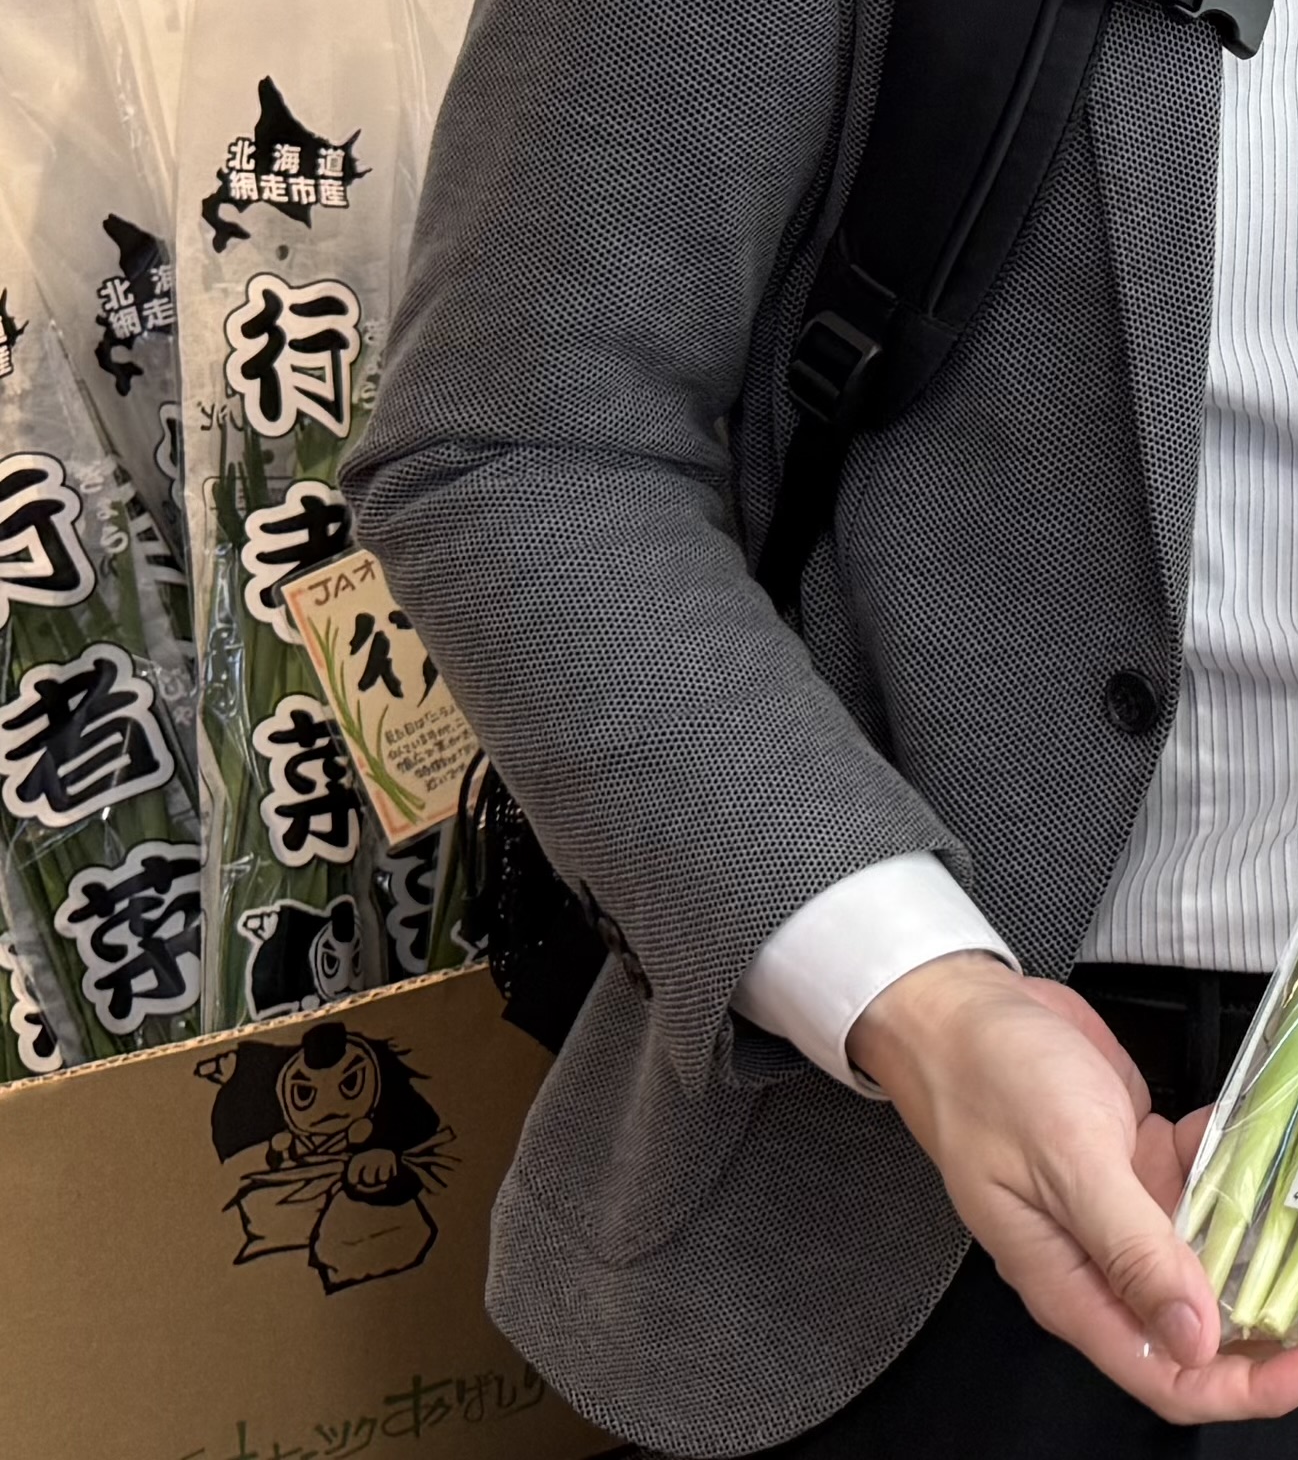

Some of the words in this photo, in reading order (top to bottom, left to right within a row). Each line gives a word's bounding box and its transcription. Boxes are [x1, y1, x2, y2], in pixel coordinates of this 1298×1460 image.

[228, 137, 346, 178] 北海道
[228, 172, 351, 209] 網走市産
